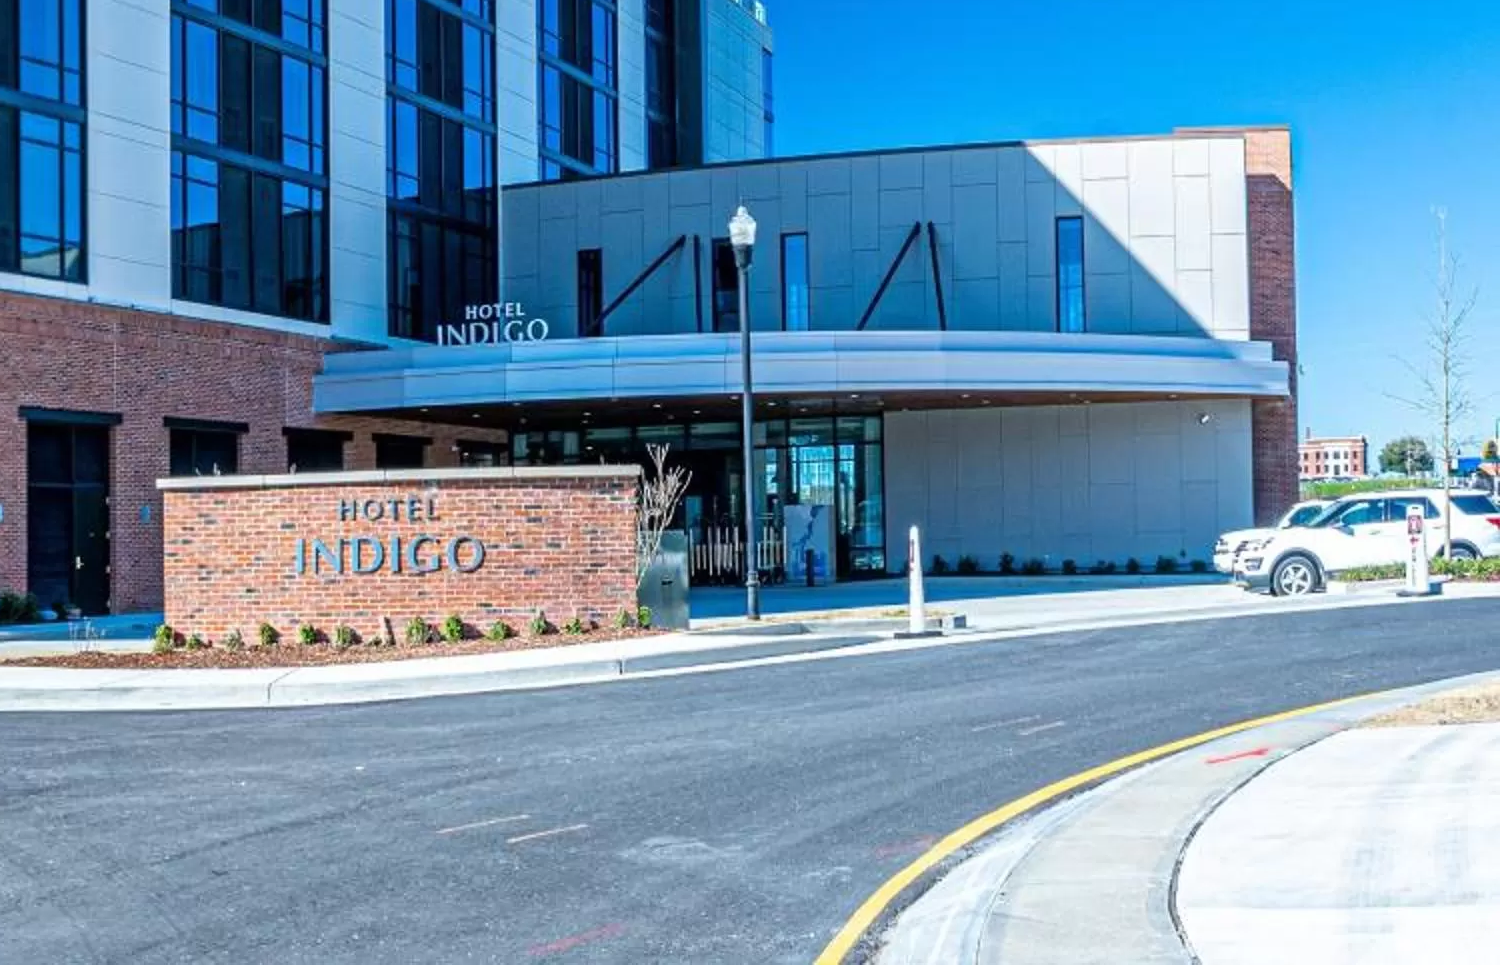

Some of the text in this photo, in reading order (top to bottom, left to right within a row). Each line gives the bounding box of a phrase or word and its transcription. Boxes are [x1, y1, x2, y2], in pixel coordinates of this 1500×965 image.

[465, 302, 526, 320] HOTEL
[436, 318, 549, 346] INDIGO
[338, 496, 441, 522] HOTEL
[295, 534, 487, 575] INDIGO
